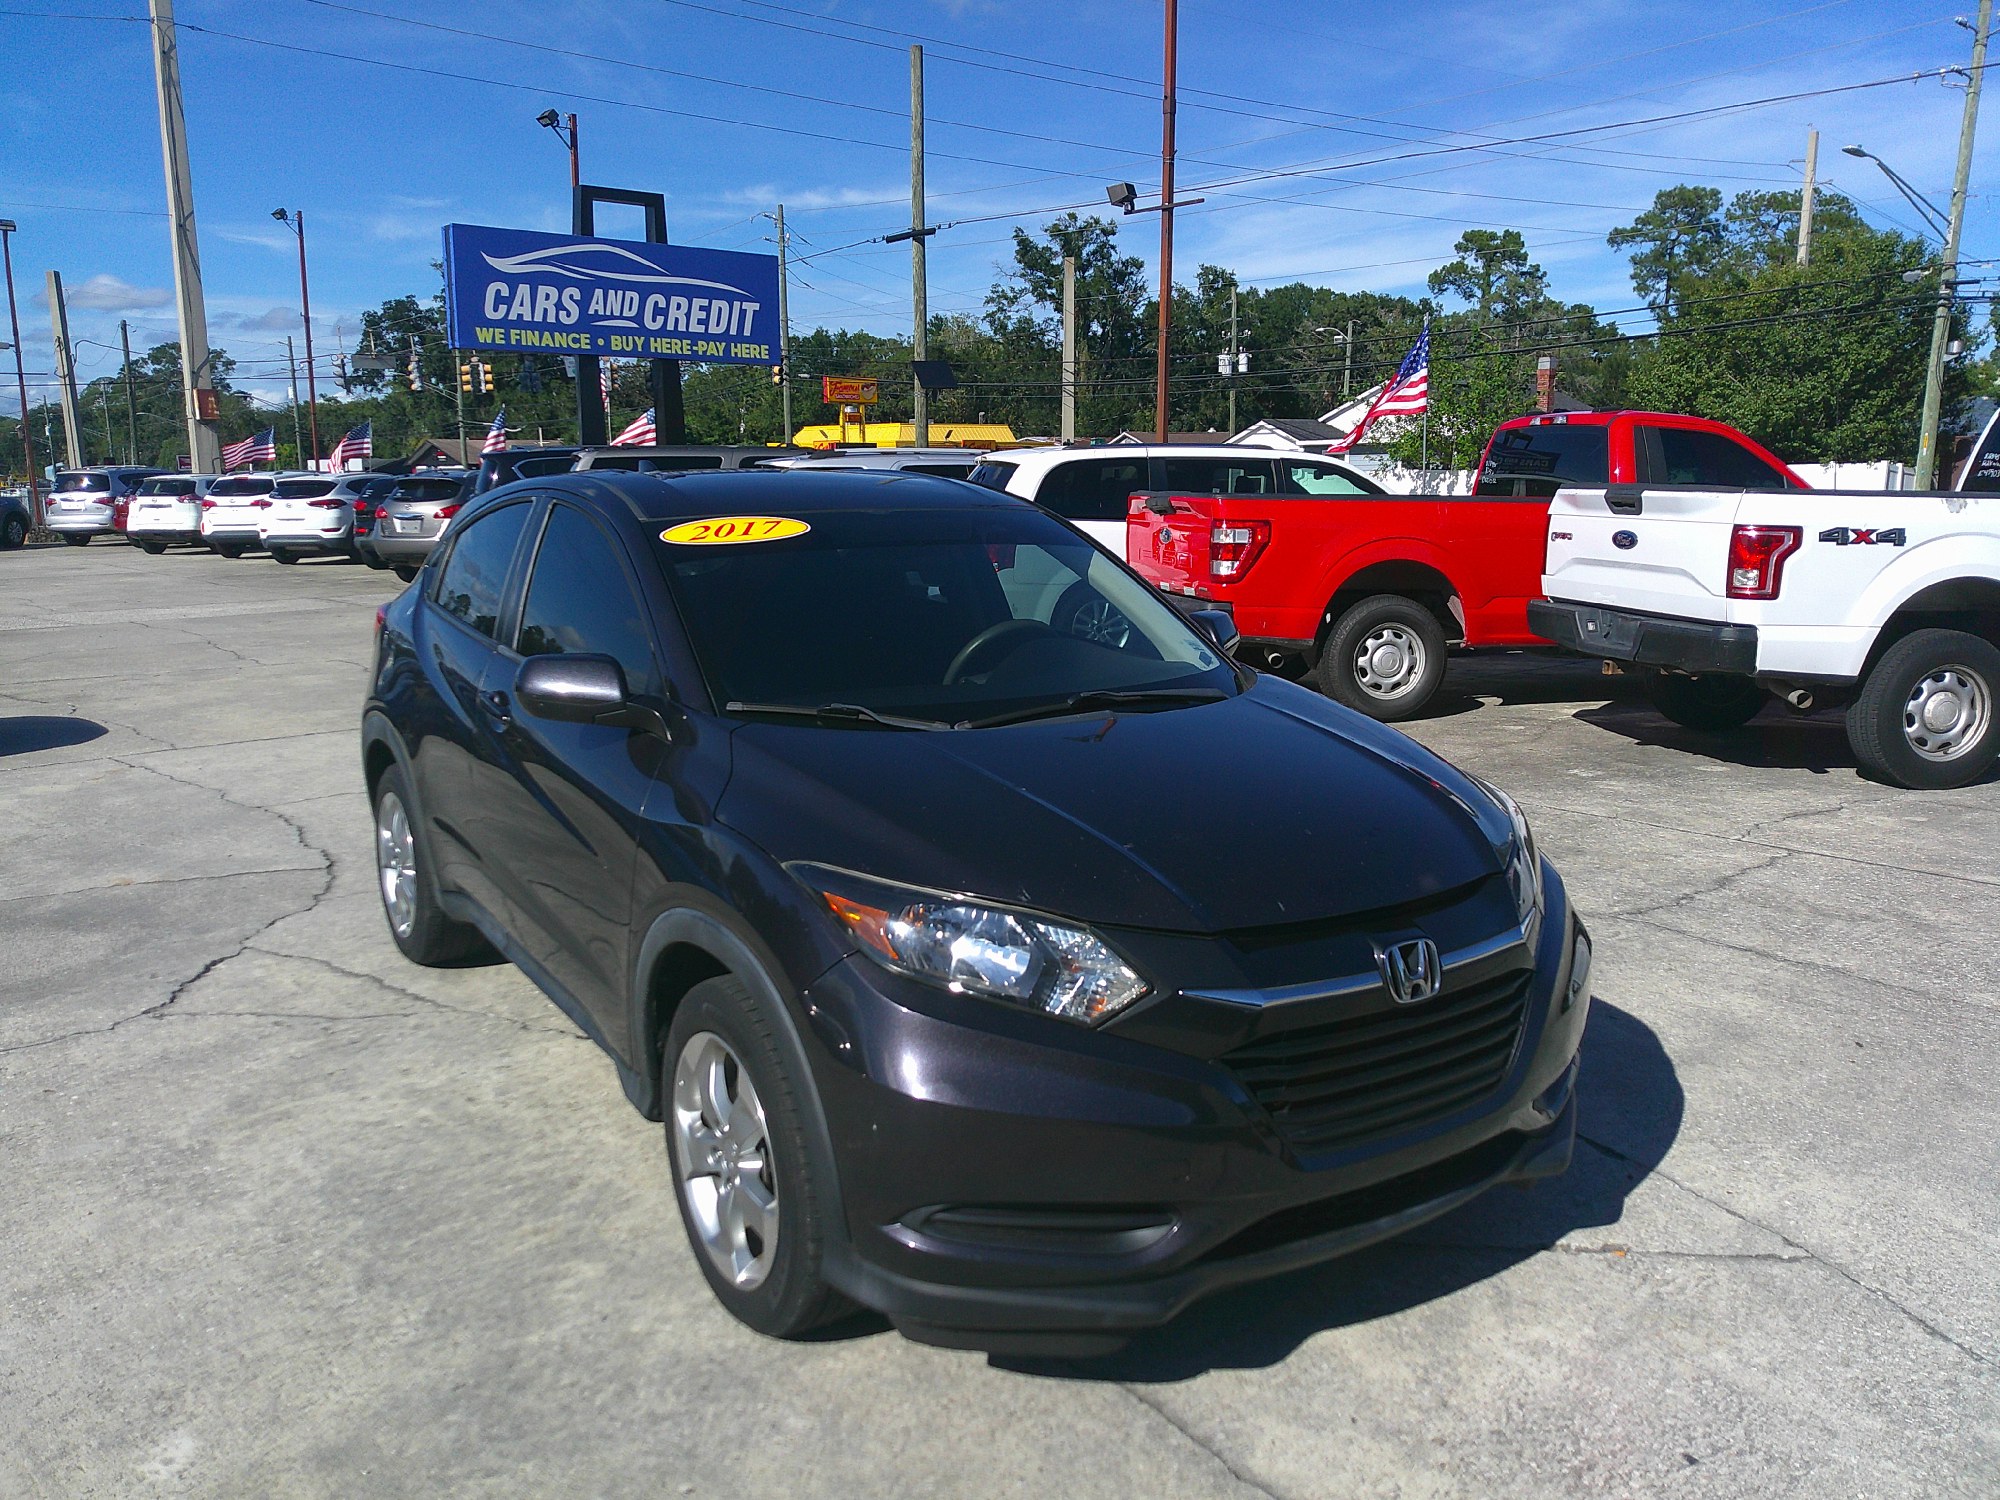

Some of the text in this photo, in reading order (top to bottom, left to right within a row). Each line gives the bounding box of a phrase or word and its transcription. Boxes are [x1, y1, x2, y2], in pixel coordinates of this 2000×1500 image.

[485, 281, 760, 337] CARS AND CREDIT
[475, 326, 506, 344] WE
[510, 328, 592, 349] FINANCE
[610, 335, 645, 352] BUY
[730, 343, 770, 359] HERE
[688, 520, 783, 541] 2017
